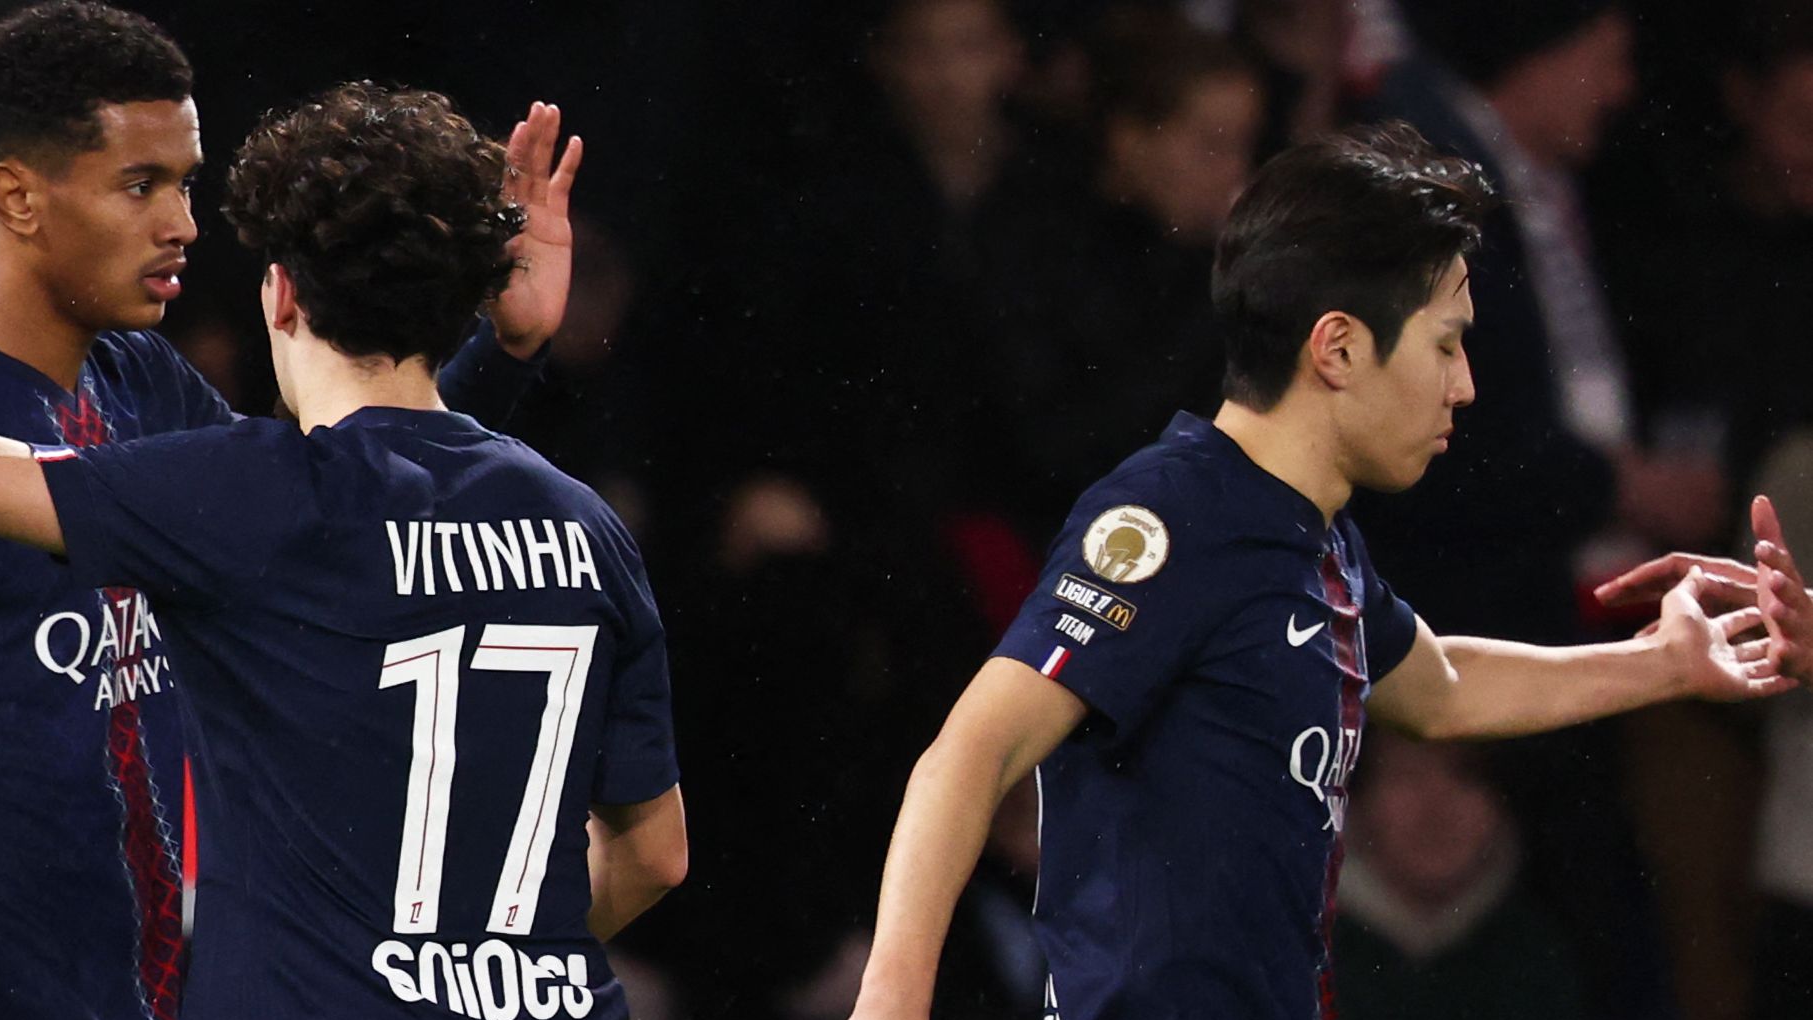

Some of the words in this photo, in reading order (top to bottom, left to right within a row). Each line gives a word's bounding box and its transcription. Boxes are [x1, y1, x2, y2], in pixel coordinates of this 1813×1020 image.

[386, 519, 602, 596] VITINHA
[1055, 578, 1100, 613] LIGUE
[378, 623, 599, 936] 17
